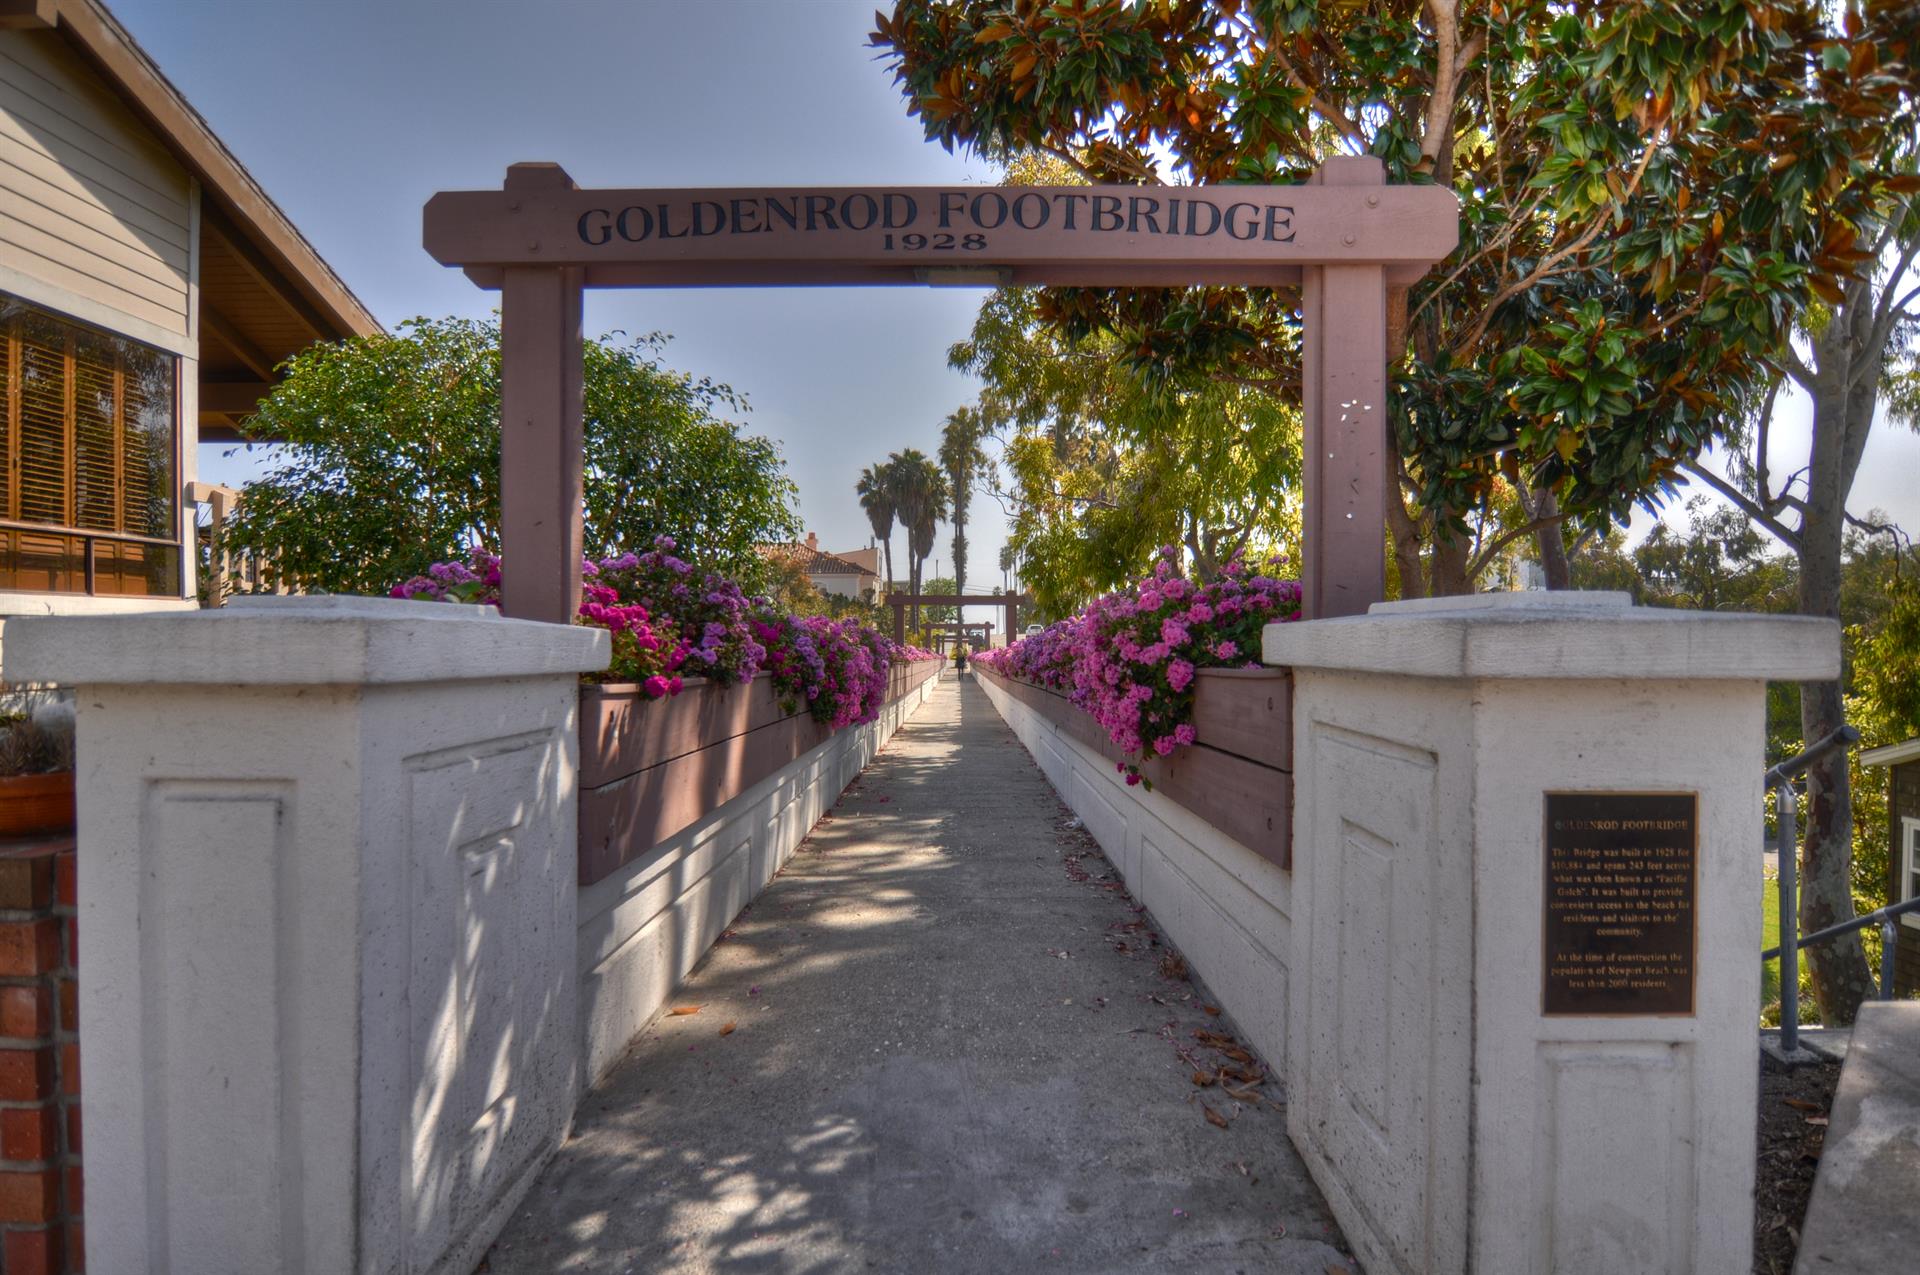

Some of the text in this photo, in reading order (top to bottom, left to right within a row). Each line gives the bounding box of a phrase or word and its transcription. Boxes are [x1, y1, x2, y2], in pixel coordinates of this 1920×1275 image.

[577, 192, 1298, 246] GOLDENROD FOOTBRIDGE
[884, 232, 988, 251] 1928
[1555, 820, 1688, 830] GOLDENROD FOOTBRIDGE
[1574, 848, 1600, 859] Bridge
[1604, 849, 1619, 857] was
[1622, 848, 1641, 857] built
[1656, 848, 1674, 857] 1928
[1678, 848, 1689, 857] for
[1587, 861, 1601, 870] and
[1604, 862, 1626, 872] spans
[1648, 861, 1662, 870] feet
[1666, 862, 1690, 870] across
[1553, 874, 1573, 883] what
[1576, 875, 1591, 883] was
[1595, 874, 1612, 883] then
[1615, 874, 1641, 883] known
[1644, 875, 1652, 883] as
[1592, 887, 1599, 896] It
[1602, 888, 1616, 896] was
[1620, 887, 1638, 896] built
[1642, 887, 1650, 896] to
[1653, 887, 1683, 898] provide
[1550, 901, 1593, 910] convenient
[1597, 902, 1622, 910] access
[1625, 901, 1633, 910] to
[1637, 901, 1648, 910] the
[1651, 901, 1675, 910] beach
[1563, 914, 1676, 923] residents and visitors to the
[1596, 927, 1643, 937] community.
[1556, 953, 1682, 962] At the time of construction the
[1552, 966, 1687, 977] population of Newport Beach was
[1569, 979, 1584, 988] less
[1588, 979, 1605, 988] than
